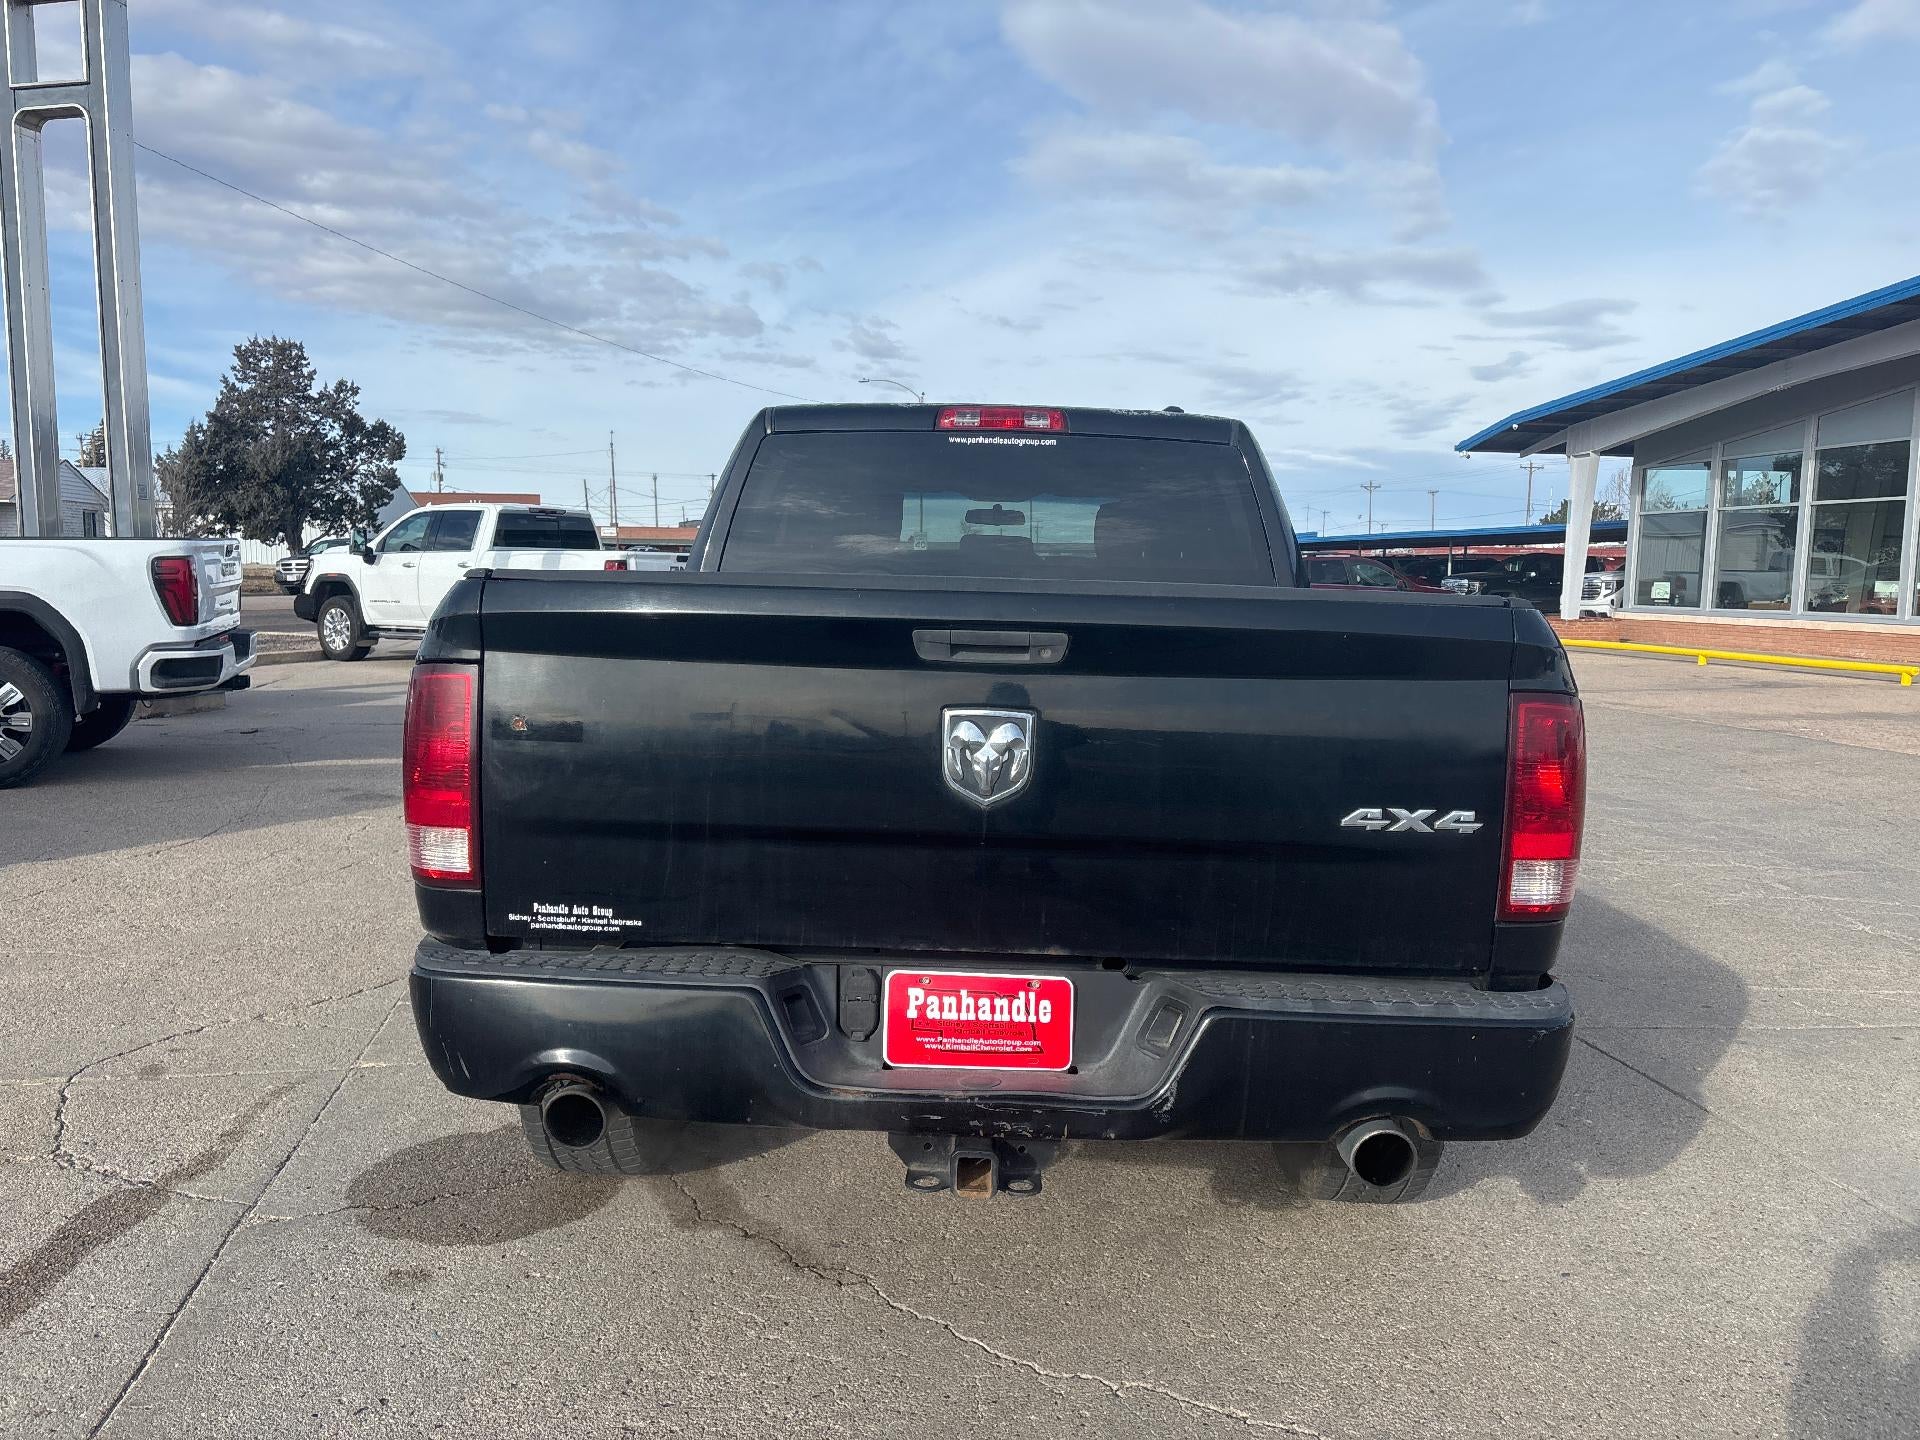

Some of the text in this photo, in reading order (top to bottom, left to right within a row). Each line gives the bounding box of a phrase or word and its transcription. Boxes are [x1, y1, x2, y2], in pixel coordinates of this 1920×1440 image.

[948, 435, 1057, 447] www.panhandleautogroup.com
[533, 902, 613, 919] Panhandle Auto Group
[508, 913, 531, 922] Sidney
[581, 917, 608, 925] Kimball
[609, 918, 642, 926] Nebraska
[530, 922, 620, 932] panhandleautogroup.com
[906, 987, 1052, 1023] Panhandle
[915, 1036, 1042, 1047] www.PanhandleAutoGroup.com
[924, 1043, 1033, 1053] www.KimballChevrolet.com
